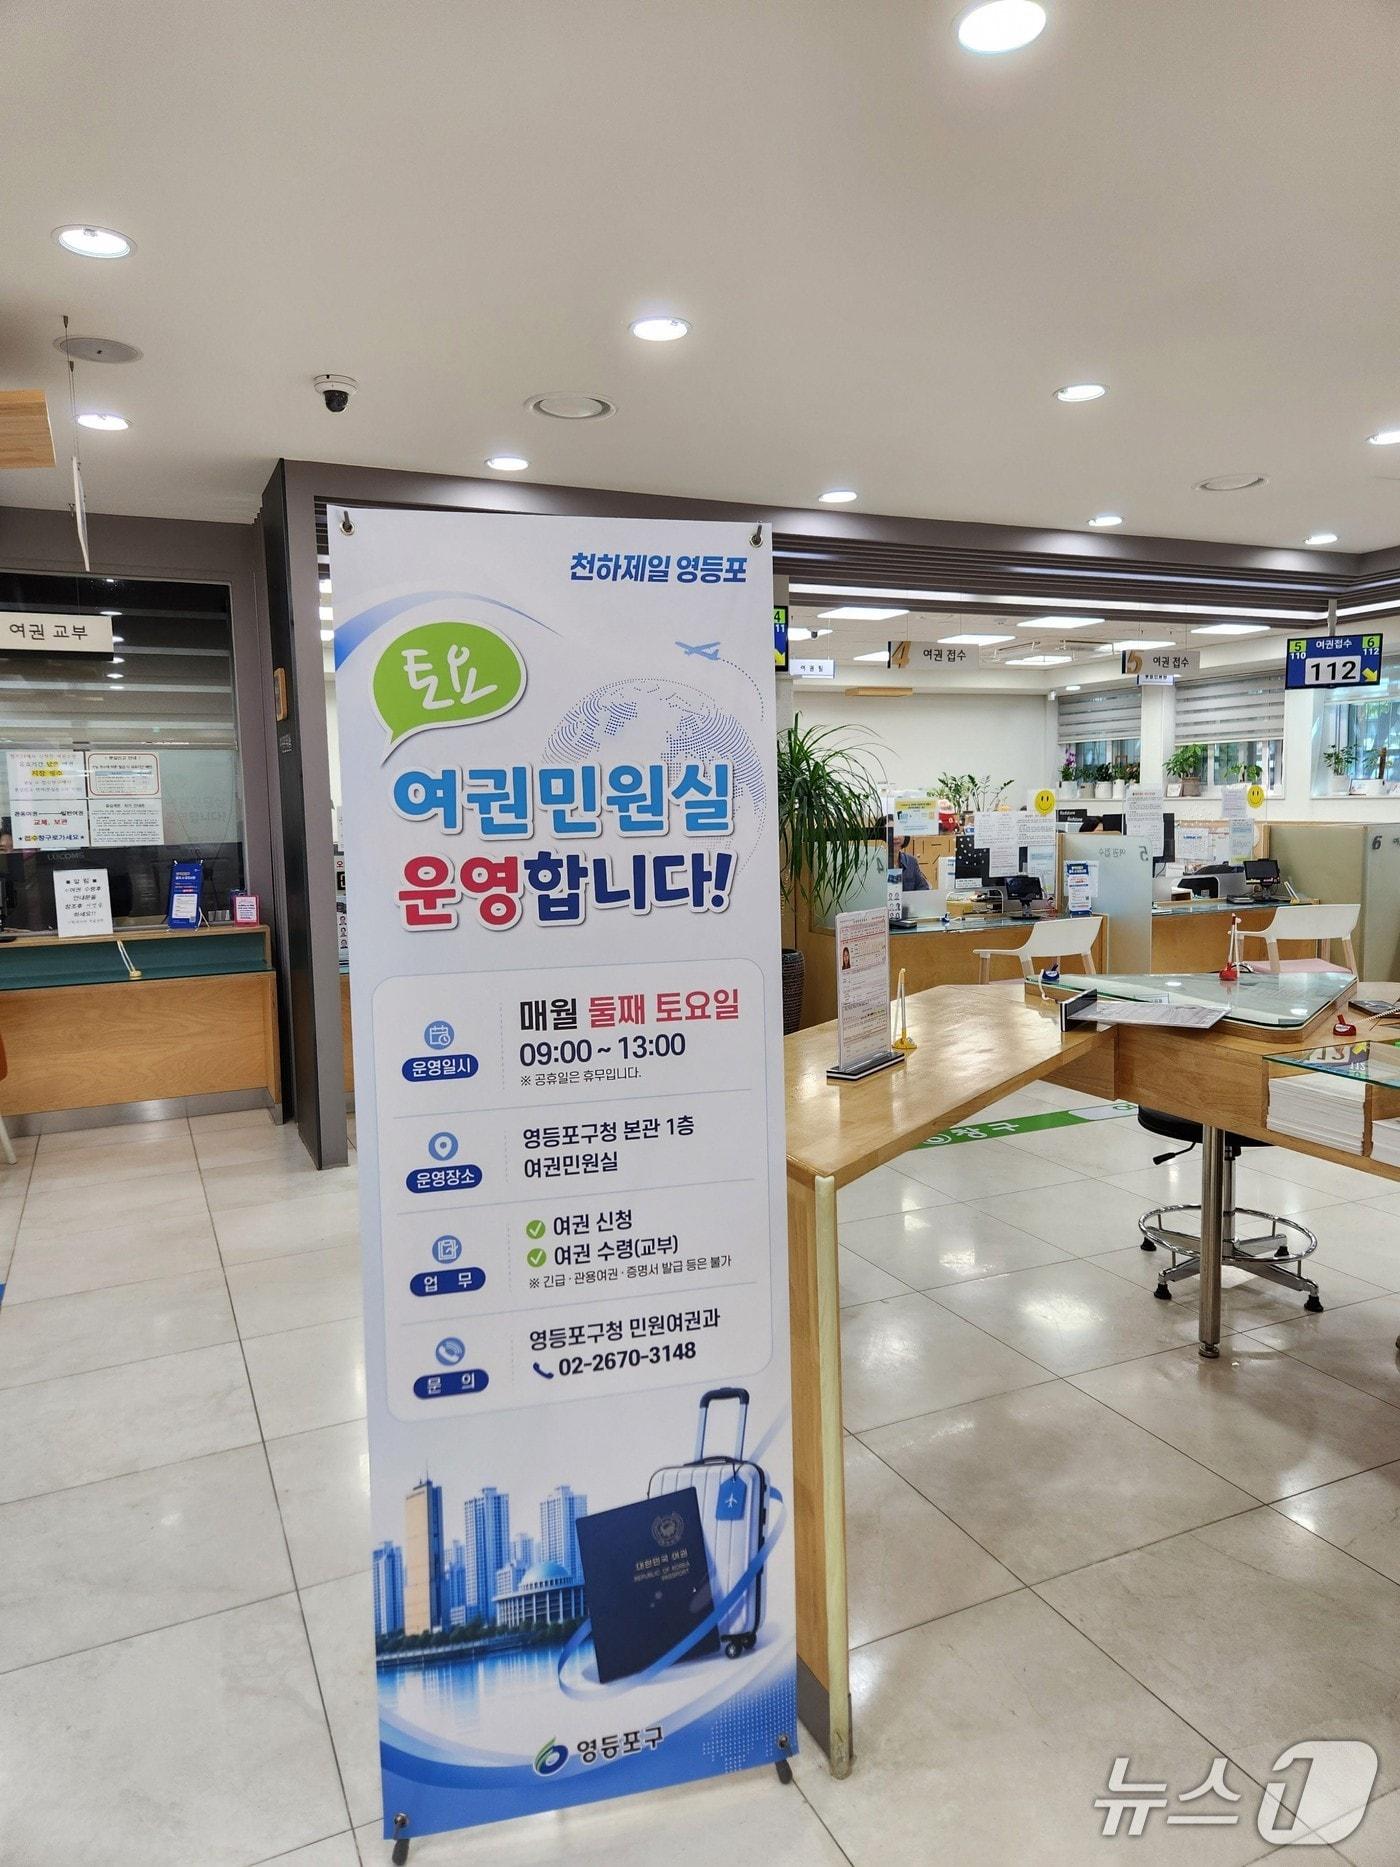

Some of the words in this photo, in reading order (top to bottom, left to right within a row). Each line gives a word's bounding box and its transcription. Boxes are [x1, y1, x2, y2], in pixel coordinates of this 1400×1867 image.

[570, 552, 671, 583] 천하제일
[676, 554, 748, 584] 영등포
[774, 611, 781, 622] 4
[9, 622, 45, 641] 여권
[52, 624, 88, 641] 교부
[1367, 637, 1375, 647] 6
[923, 649, 943, 662] 여권
[947, 649, 966, 662] 접수
[1294, 641, 1302, 652] 5
[1316, 638, 1352, 650] 여권접수
[1153, 656, 1170, 668] 여권
[1173, 656, 1189, 668] 접수
[1290, 652, 1306, 660] 110
[1311, 661, 1356, 681] 112
[393, 763, 730, 838] 여권민원실
[1372, 835, 1382, 850] 6
[399, 850, 734, 927] 운영합니다!
[519, 997, 578, 1032] 매월
[588, 994, 646, 1029] 둘째
[655, 988, 740, 1024] 토요일
[519, 1040, 592, 1066] 09:00
[617, 1033, 686, 1060] 13:00
[411, 1058, 472, 1078] 운영일시
[534, 1070, 580, 1087] 공휴일은
[582, 1067, 642, 1085] 휴무입니다.
[523, 1121, 617, 1149] 영등포구청
[623, 1118, 660, 1141] 본관
[667, 1115, 695, 1137] 1층
[524, 1152, 619, 1180] 여권민원실
[416, 1168, 475, 1190] 운영장소
[553, 1213, 590, 1237] 여권
[596, 1209, 633, 1233] 신청
[554, 1243, 591, 1268] 여권
[597, 1234, 679, 1263] 수령(교부)
[424, 1275, 439, 1293] 업
[458, 1271, 474, 1290] 무
[543, 1273, 566, 1289] 긴급
[573, 1268, 618, 1285] 관용여권
[626, 1264, 660, 1279] 증명서
[662, 1260, 683, 1275] 발급
[686, 1256, 707, 1272] 등은
[710, 1254, 732, 1270] 불가
[529, 1322, 624, 1352] 영등포구청
[629, 1307, 721, 1338] 민원여권과
[558, 1342, 697, 1377] 02-2670-3148
[426, 1378, 442, 1395] 문
[461, 1372, 476, 1391] 의
[636, 1554, 669, 1571] 대한민국
[671, 1548, 688, 1560] 여권
[576, 1726, 663, 1765] 영등포구
